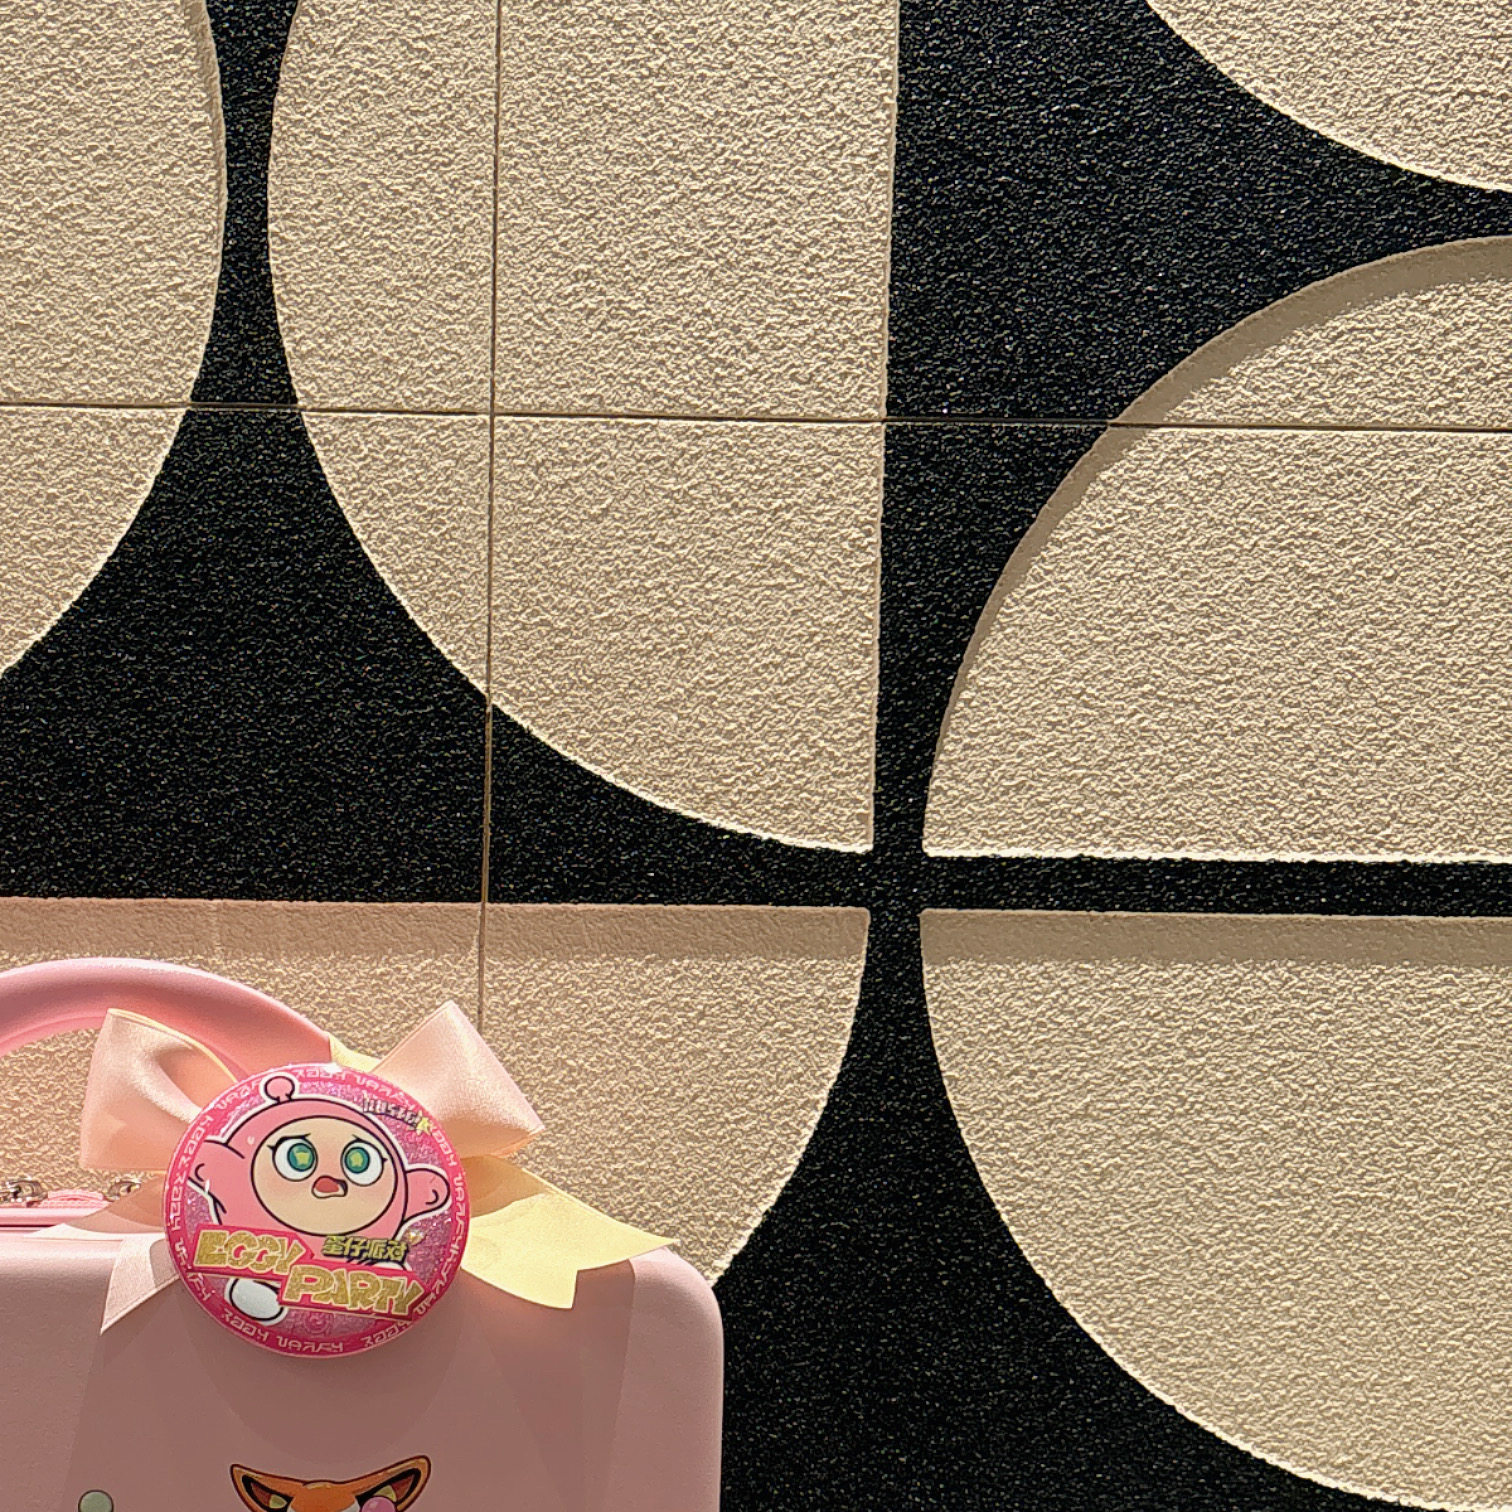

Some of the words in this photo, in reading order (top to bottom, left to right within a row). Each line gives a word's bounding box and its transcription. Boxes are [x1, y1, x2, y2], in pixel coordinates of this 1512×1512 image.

[193, 1229, 306, 1274] EGGY
[323, 1236, 410, 1262] 蛋仔派对
[284, 1263, 424, 1316] PARTY
